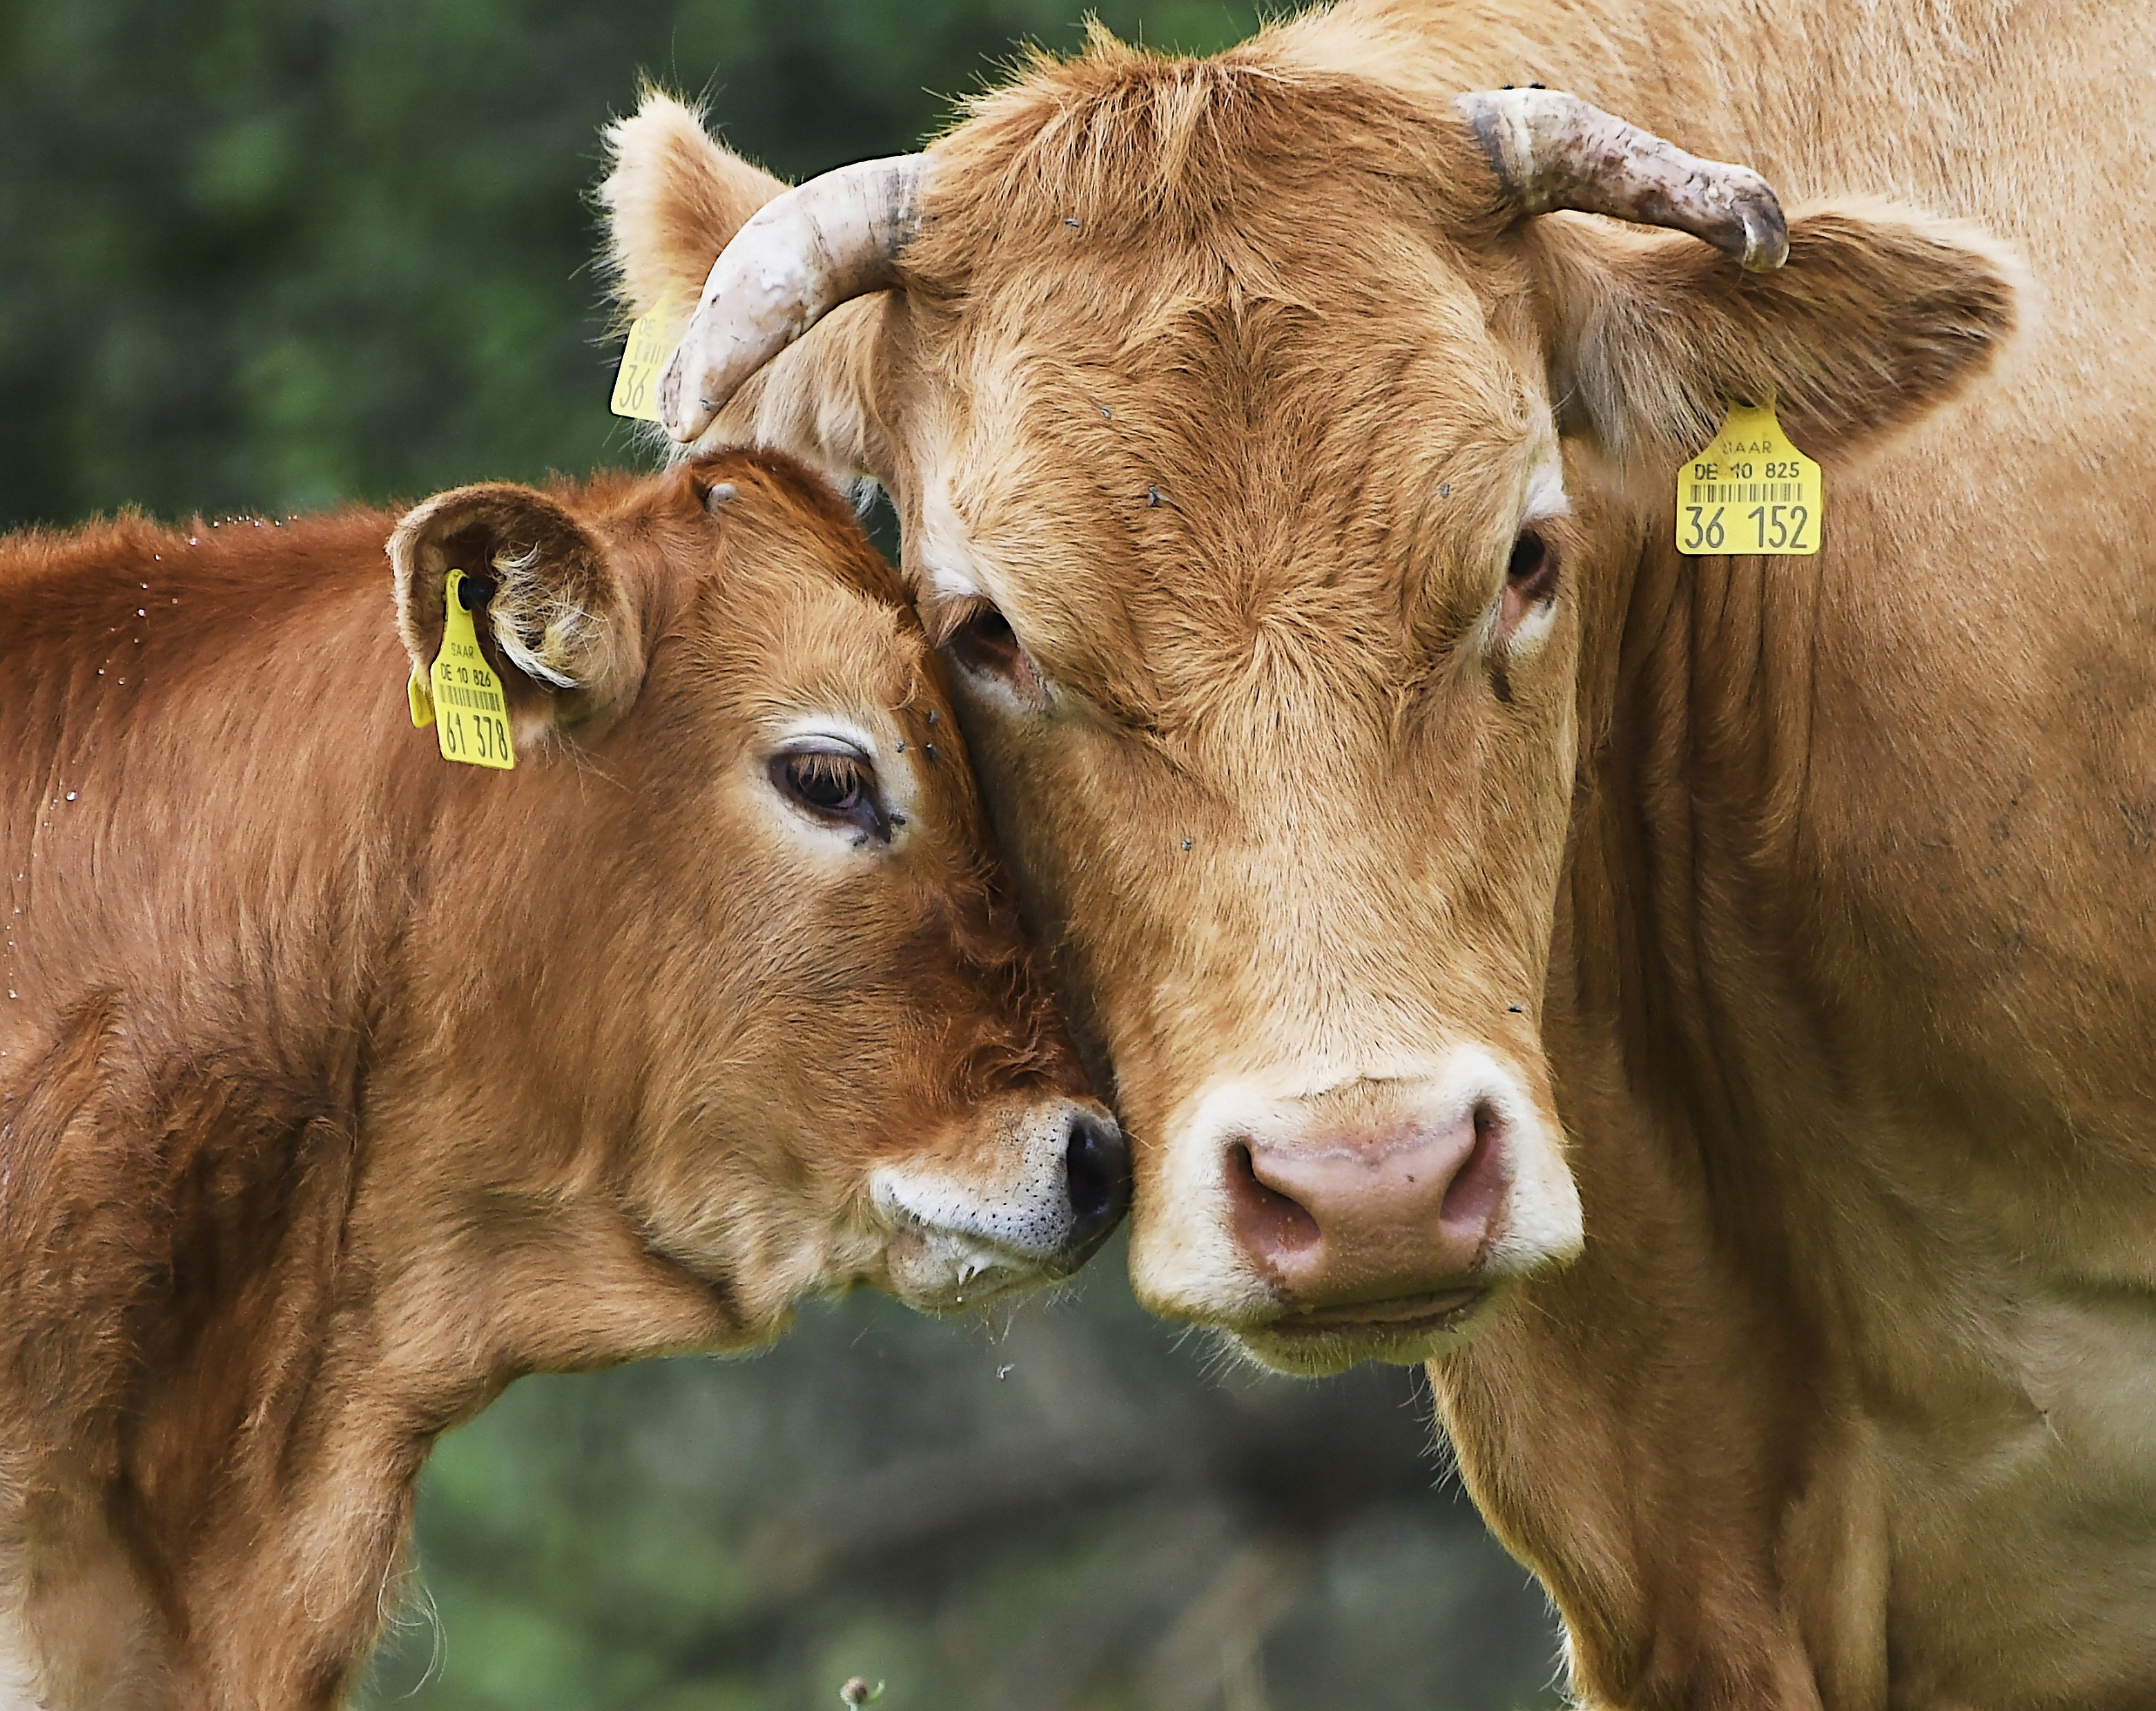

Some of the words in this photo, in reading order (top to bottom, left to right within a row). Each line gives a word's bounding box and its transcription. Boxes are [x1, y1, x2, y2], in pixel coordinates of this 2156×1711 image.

[619, 364, 650, 410] 36
[1694, 463, 1718, 480] DE
[1730, 463, 1754, 479] 10
[1765, 462, 1800, 478] 825
[1684, 506, 1725, 549] 36
[1748, 506, 1807, 549] 152
[450, 643, 474, 659] SAAR
[440, 663, 452, 681] DE
[456, 666, 469, 683] 10
[473, 669, 491, 687] 826
[447, 711, 466, 755] 61
[473, 714, 508, 761] 378
